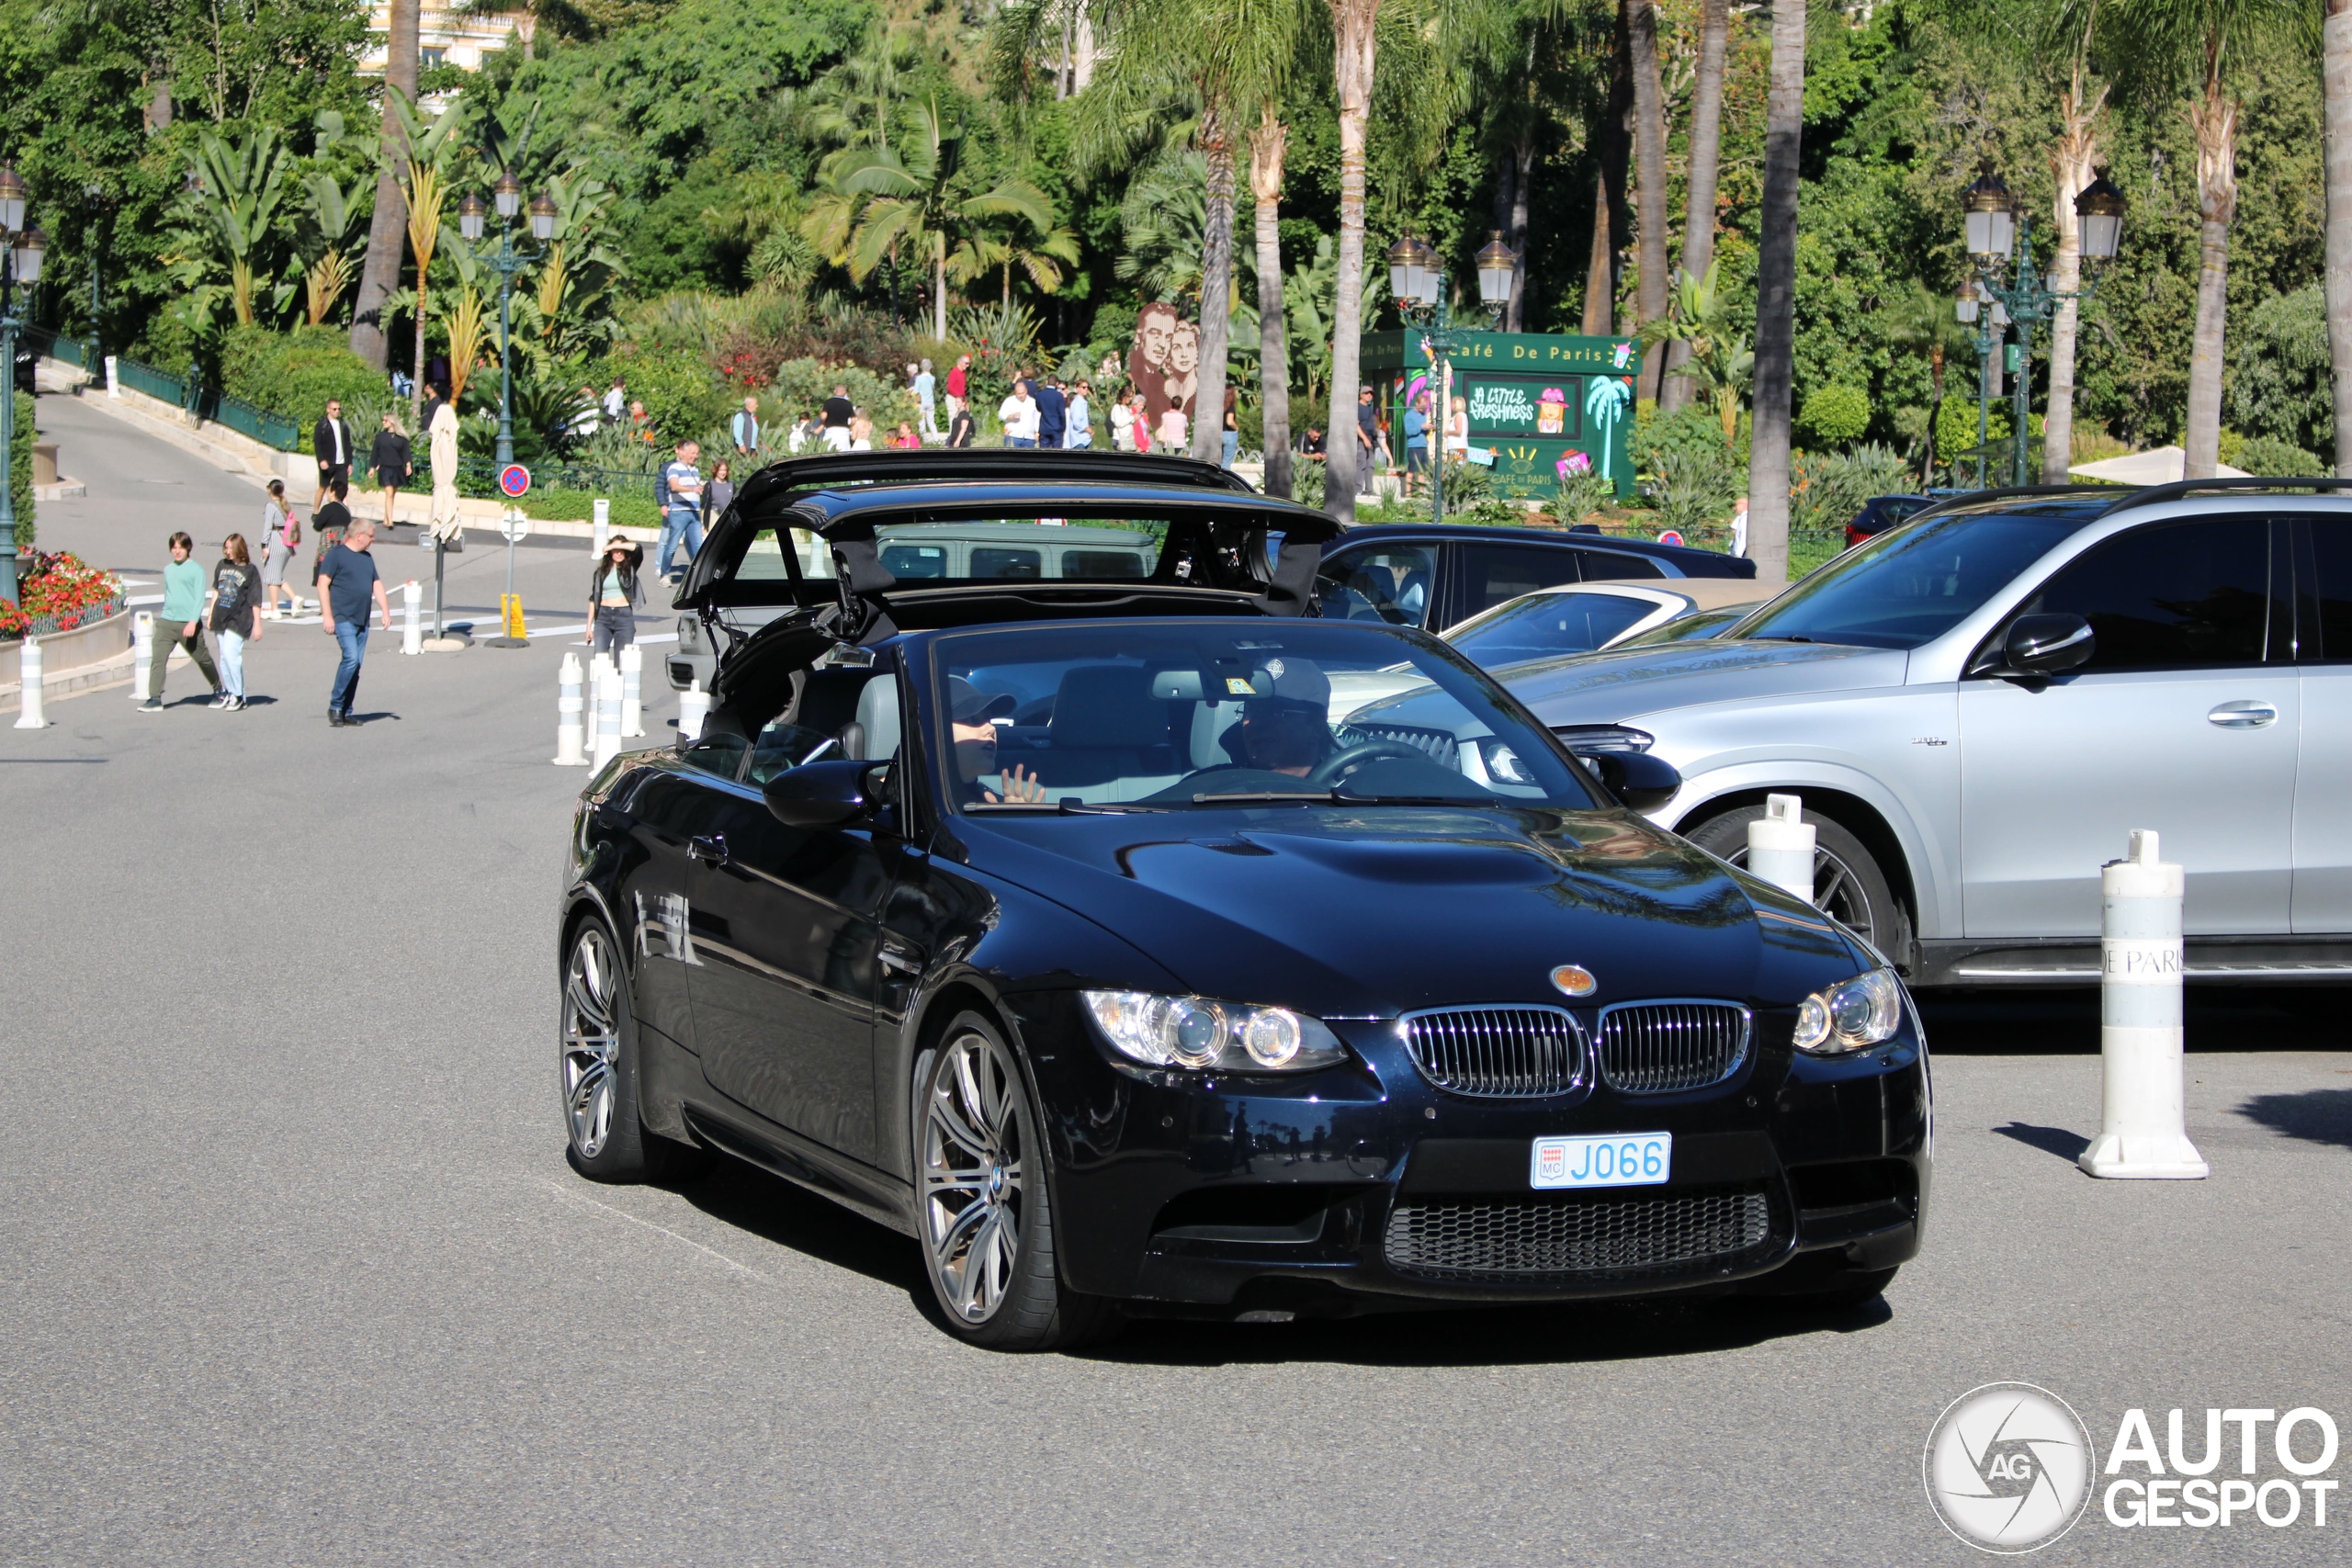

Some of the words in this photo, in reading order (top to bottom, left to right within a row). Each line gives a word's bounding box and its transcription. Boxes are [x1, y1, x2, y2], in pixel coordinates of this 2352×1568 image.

[1513, 345, 1538, 359] De
[1550, 346, 1601, 362] Paris
[1475, 386, 1485, 403] A
[1469, 449, 1489, 463] OVE
[1527, 474, 1552, 486] PARIS
[1543, 1163, 1561, 1174] MC
[1570, 1141, 1663, 1180] J066
